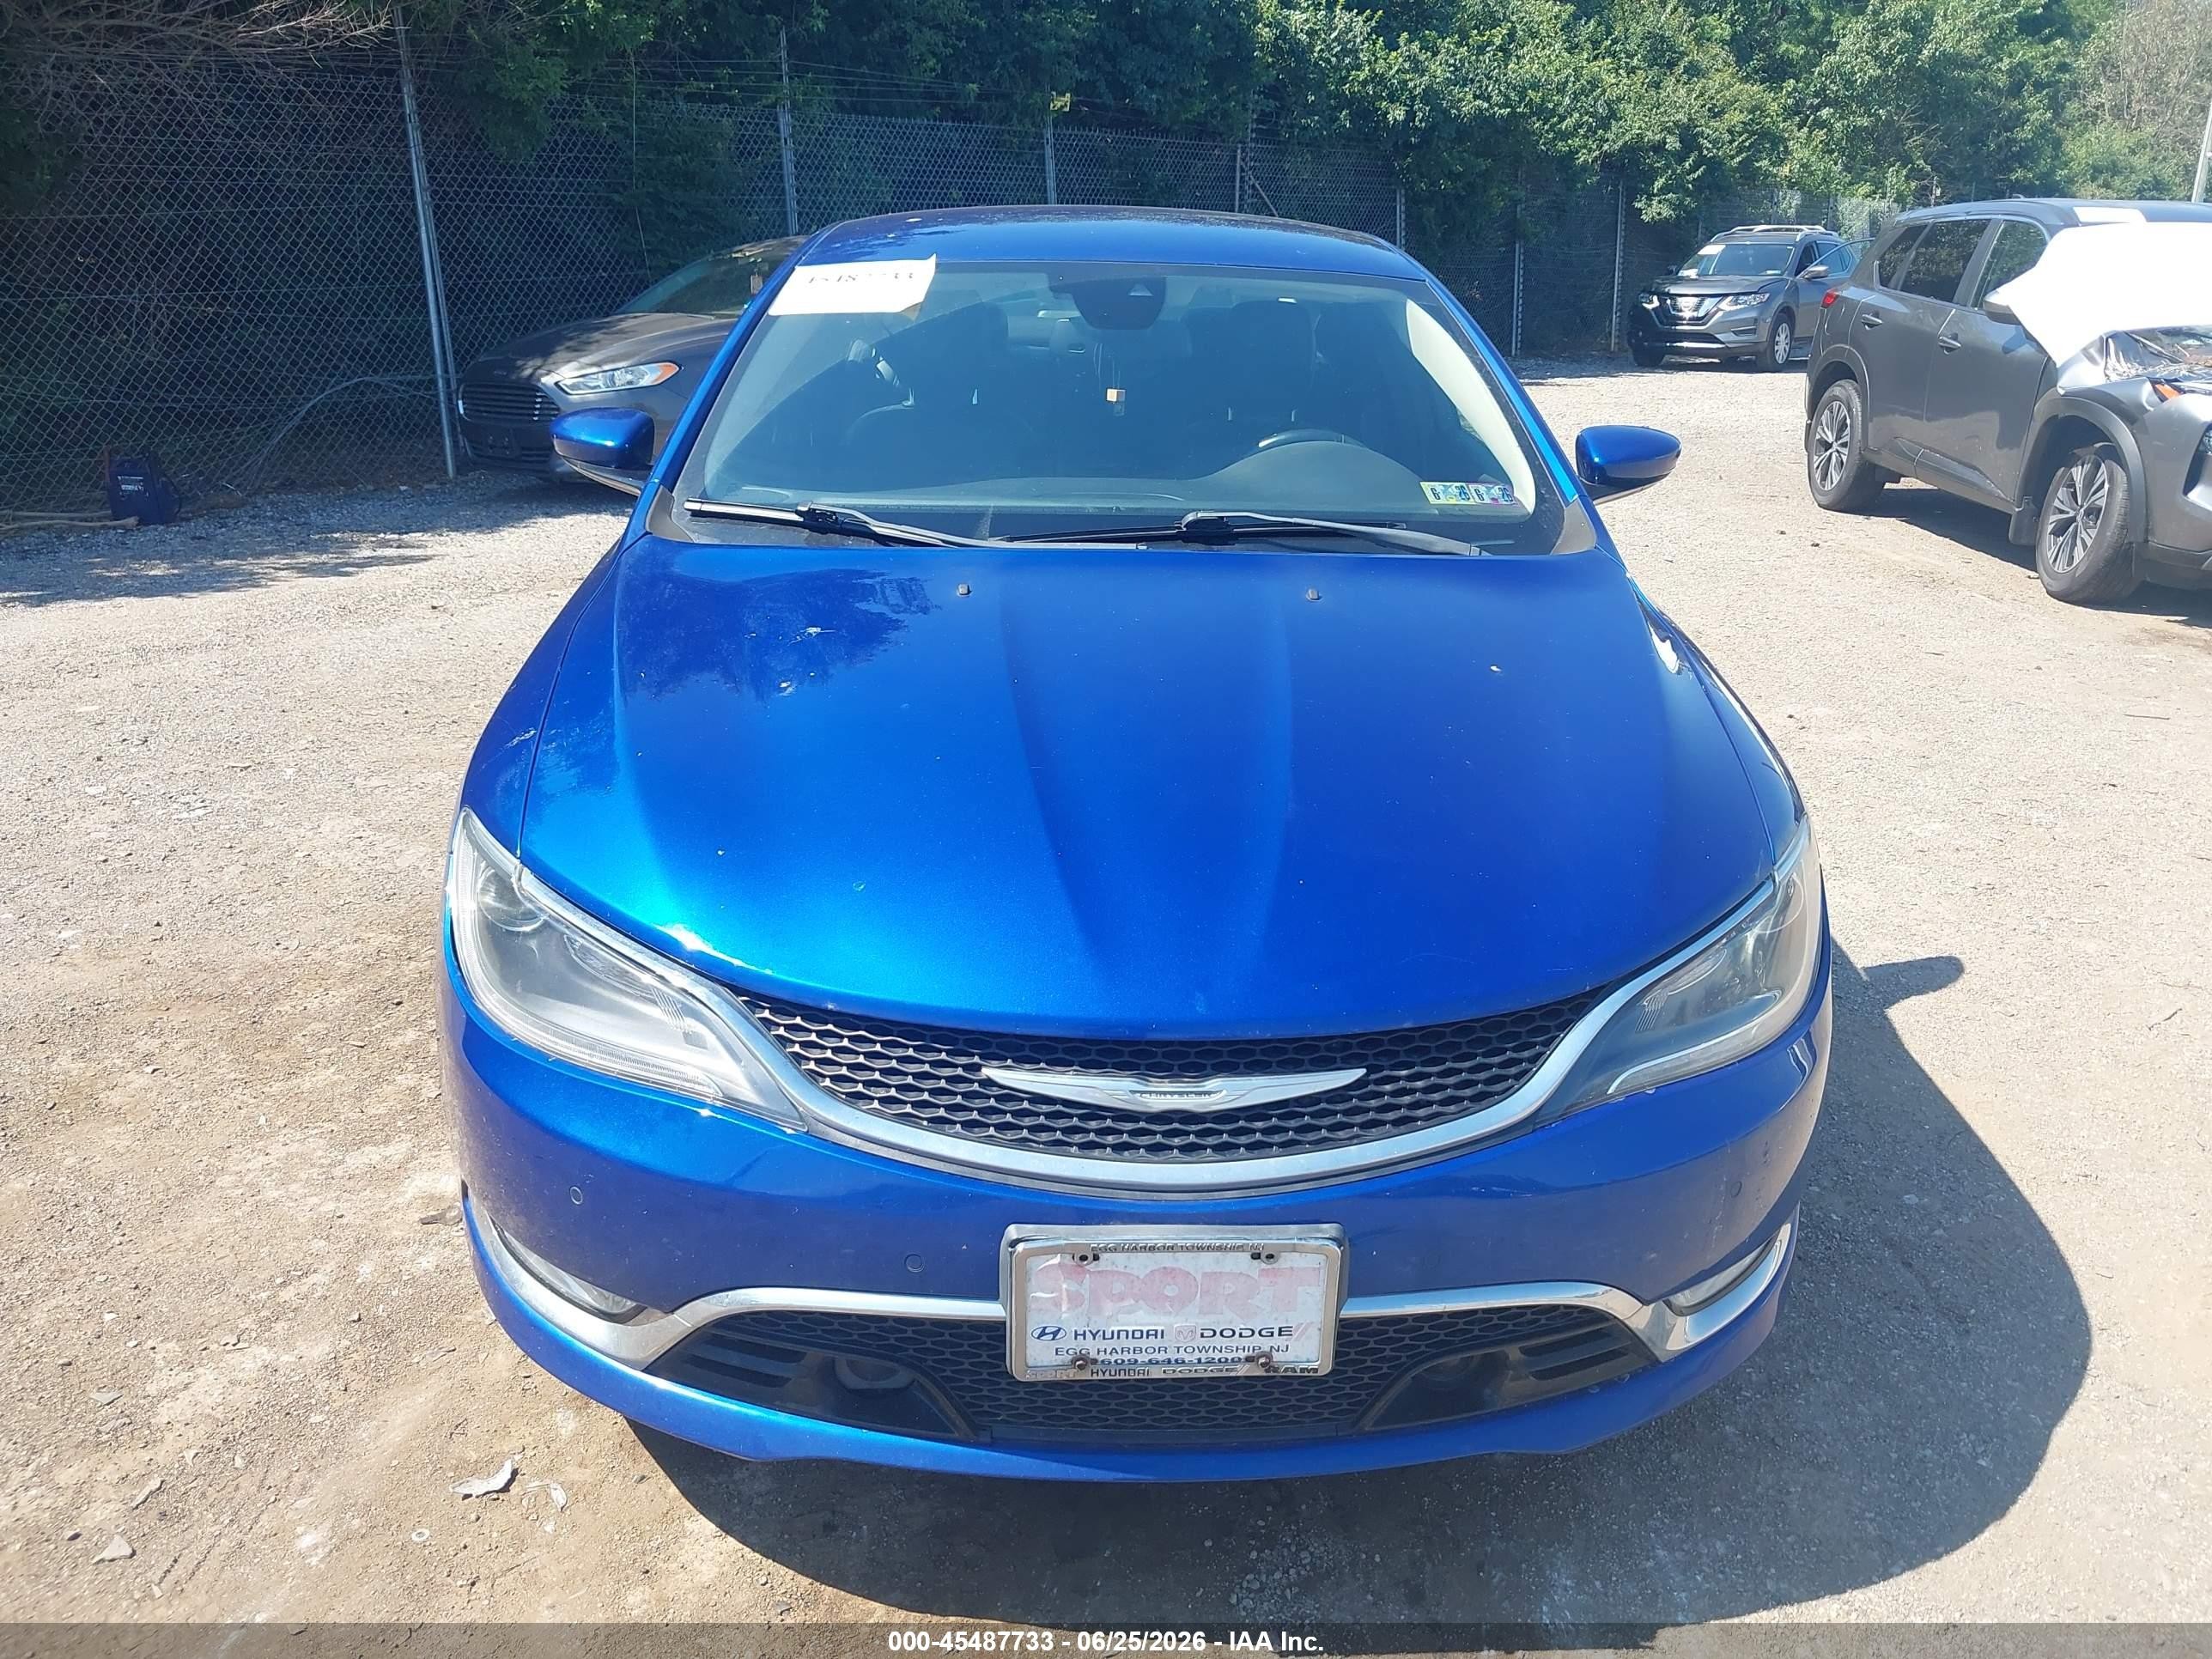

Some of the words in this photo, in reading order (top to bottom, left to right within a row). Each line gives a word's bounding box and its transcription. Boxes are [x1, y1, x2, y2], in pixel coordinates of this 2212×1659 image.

[1091, 1243, 1117, 1252] EGG
[1121, 1243, 1175, 1252] HARBOR
[1249, 1243, 1265, 1251] NJ
[1030, 1261, 1321, 1320] SPORT
[1073, 1328, 1164, 1340] HYUNDAI
[1200, 1326, 1293, 1339] DODGE
[1054, 1346, 1091, 1356] EGG
[1097, 1346, 1168, 1356] HARBOR
[1270, 1344, 1290, 1353] NJ
[1090, 1367, 1150, 1377] HYUNDAI
[1162, 1365, 1237, 1374] DODGE
[1264, 1365, 1319, 1374] RAM
